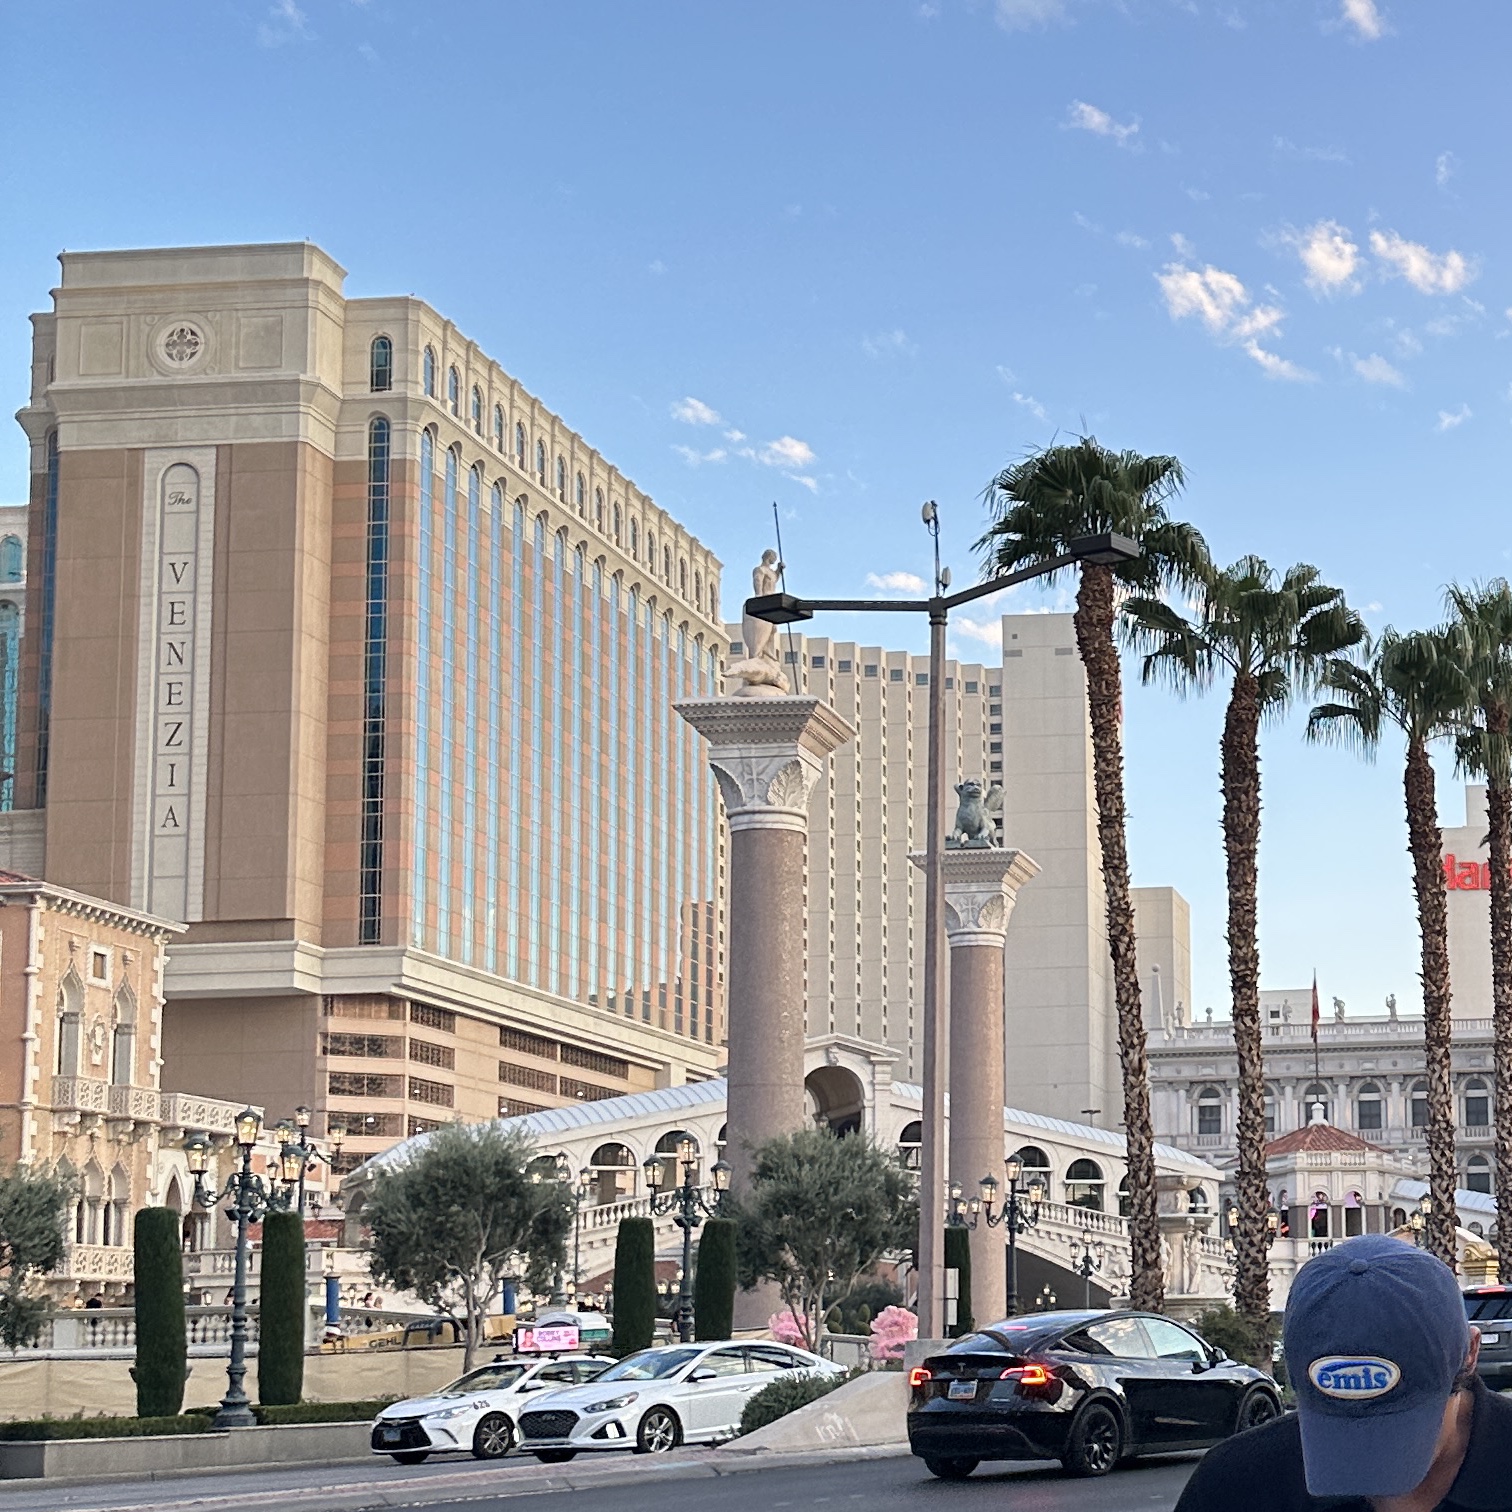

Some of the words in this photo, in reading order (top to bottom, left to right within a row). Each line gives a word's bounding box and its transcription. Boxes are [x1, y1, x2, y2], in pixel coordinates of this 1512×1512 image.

[168, 491, 193, 506] The
[161, 562, 189, 828] VENEZIA
[1317, 1366, 1388, 1390] emis
